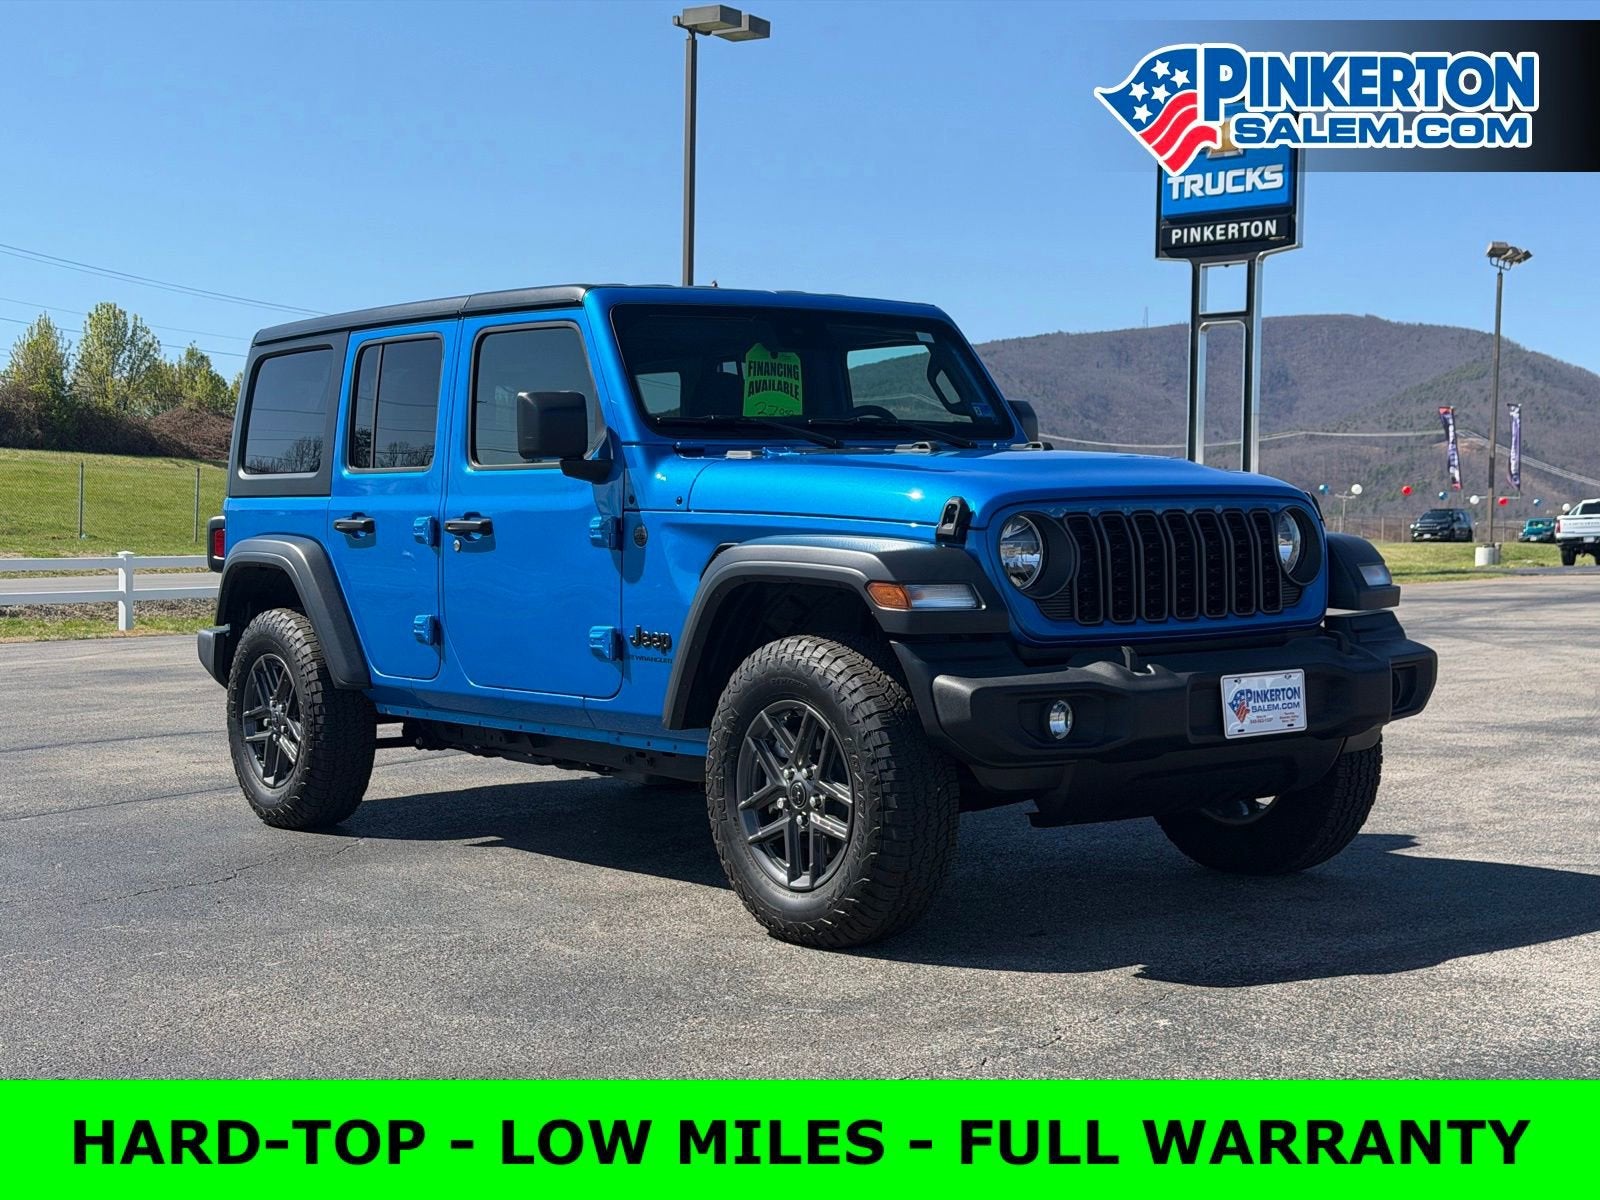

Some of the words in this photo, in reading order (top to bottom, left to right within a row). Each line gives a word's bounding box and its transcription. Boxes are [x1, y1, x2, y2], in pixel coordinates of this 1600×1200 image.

[1167, 164, 1284, 200] TRUCKS
[1171, 220, 1277, 245] PINKERTON
[748, 360, 800, 380] FINANCING
[748, 379, 800, 401] AVAILABLE
[629, 624, 673, 656] Jeep
[1246, 686, 1301, 707] PINKERTON
[1251, 702, 1300, 713] SALEM.COM
